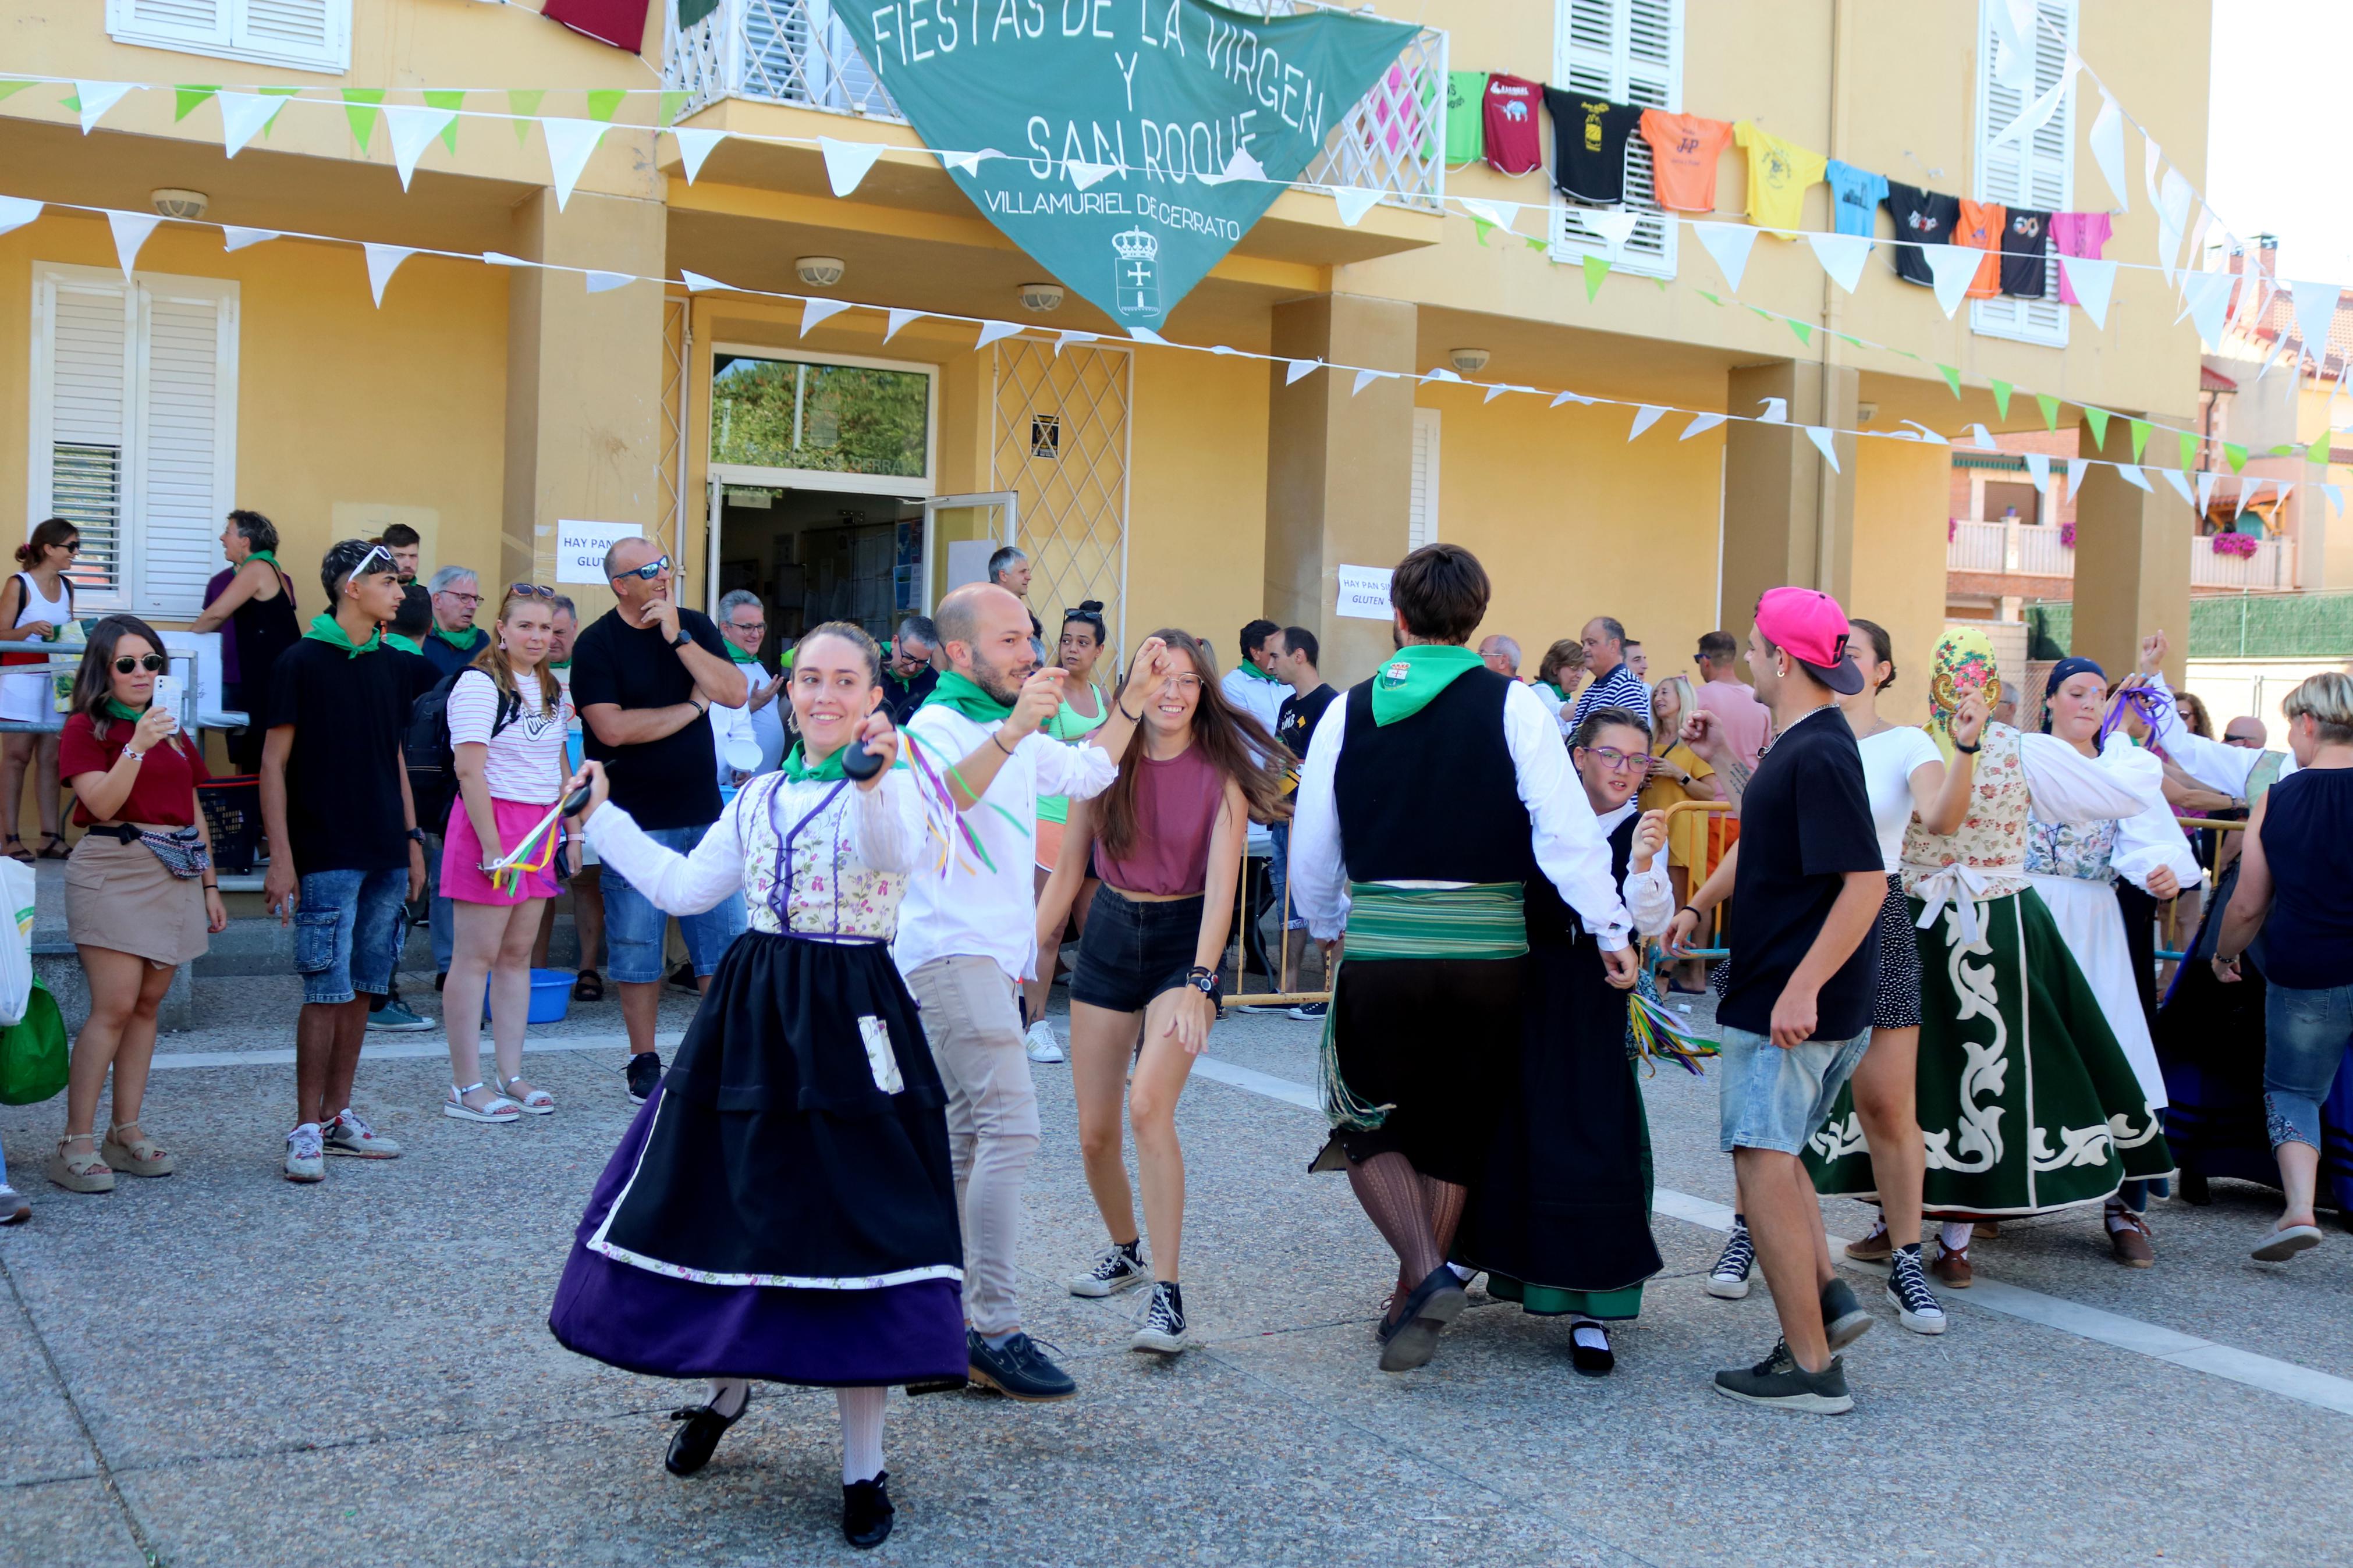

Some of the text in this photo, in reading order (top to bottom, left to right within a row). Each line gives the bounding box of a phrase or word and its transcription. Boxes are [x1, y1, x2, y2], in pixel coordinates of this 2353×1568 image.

[872, 0, 1324, 148] FIESTAS DE LA VIRGEN
[1115, 51, 1138, 112] Y
[1027, 115, 1127, 181] SAN
[984, 190, 1240, 241] VILLAMURIEL DE CERRATO
[564, 538, 614, 549] HAY PAN
[1343, 579, 1360, 588] HAY
[1362, 581, 1379, 589] PAN
[1352, 595, 1385, 605] GLUTEN
